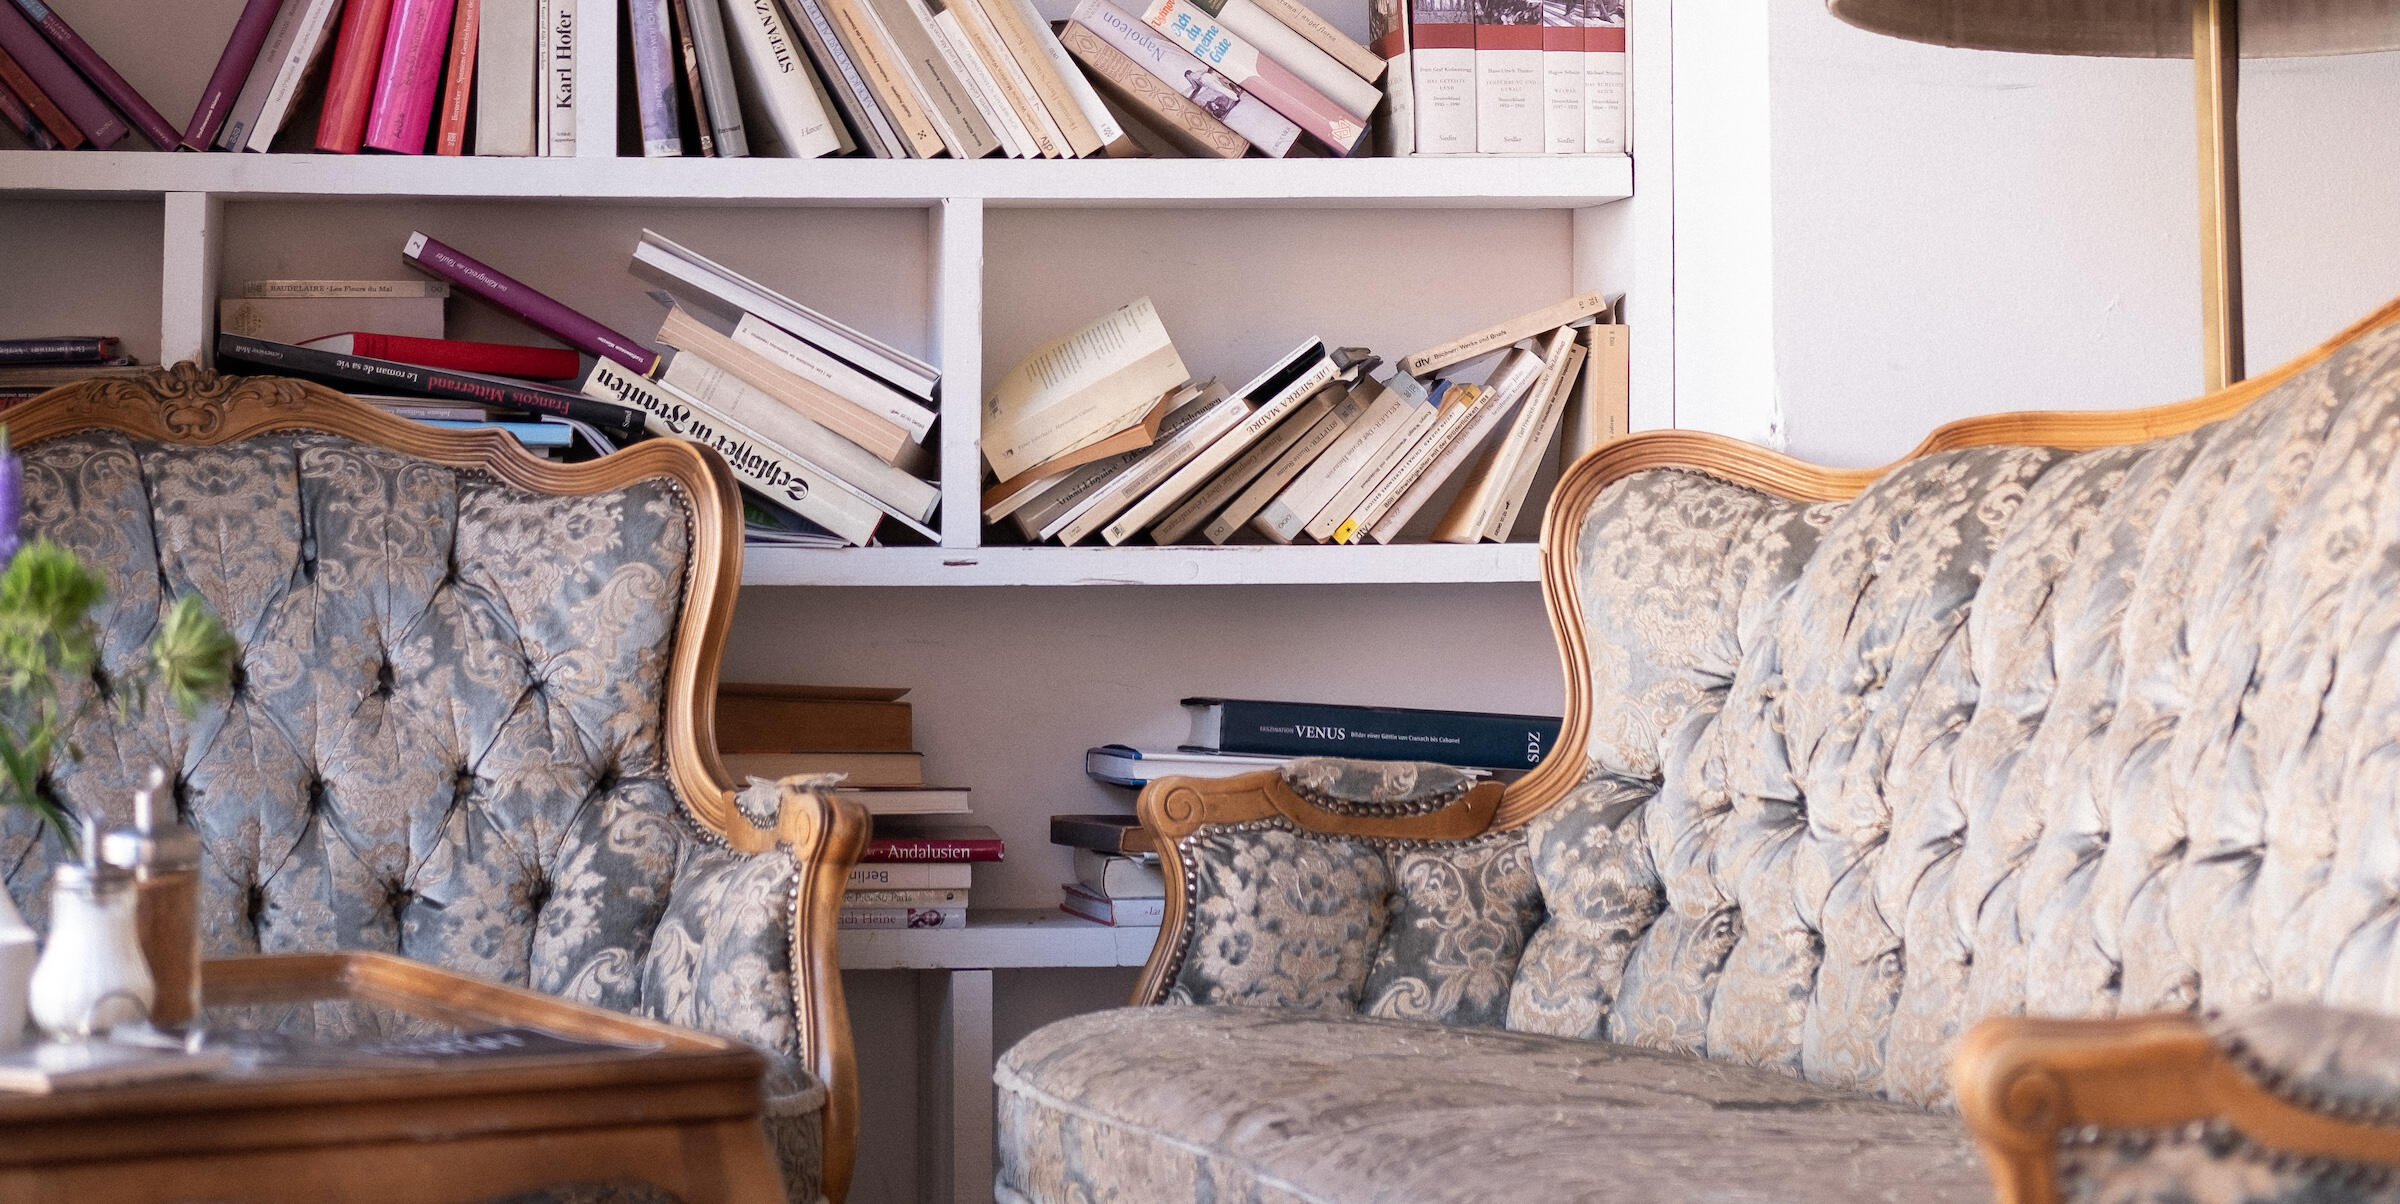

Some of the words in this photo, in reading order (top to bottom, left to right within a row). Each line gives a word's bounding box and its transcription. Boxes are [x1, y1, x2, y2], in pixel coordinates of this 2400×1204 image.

[555, 10, 572, 61] Hofer
[1103, 11, 1168, 62] Napoleon
[1171, 12, 1192, 37] Ach
[1186, 24, 1202, 42] du
[761, 15, 795, 74] STEFAN
[1193, 25, 1219, 58] meine
[1208, 38, 1232, 64] Güte
[556, 67, 572, 109] Karl
[1037, 133, 1055, 153] dtv
[462, 263, 499, 290] Königreich
[269, 285, 325, 293] BAUDELAIRE
[327, 285, 341, 293] Les
[343, 285, 365, 293] Fleurs
[367, 285, 376, 293] du
[378, 285, 393, 293] Mal
[235, 344, 252, 354] Moll
[1432, 346, 1458, 360] Büchner:
[1458, 339, 1478, 351] Werke
[1478, 335, 1490, 344] und
[1489, 329, 1507, 340] Briefe
[336, 359, 350, 370] vie
[350, 363, 361, 372] sa
[361, 362, 373, 374] de
[374, 367, 405, 381] roman
[1413, 355, 1431, 369] dtv
[405, 371, 418, 383] Le
[427, 376, 505, 403] Mitterrand
[596, 368, 691, 433] Franken
[1279, 377, 1315, 410] SIERRA
[505, 394, 570, 416] François
[1373, 400, 1401, 429] KELLER
[690, 420, 712, 443] in
[1244, 402, 1281, 437] MADRE
[1393, 456, 1433, 496] Schwierigkeiten
[1428, 446, 1440, 458] mit
[1436, 438, 1448, 449] der
[1444, 404, 1481, 441] Brüderlichkeit
[711, 433, 811, 501] Schlösser
[1355, 524, 1369, 539] dtv
[1295, 725, 1346, 740] VENUS
[1408, 734, 1429, 743] Cranach
[1439, 736, 1460, 744] Cabanel
[1527, 731, 1540, 762] SDZ
[887, 844, 970, 859] Andalusien
[849, 871, 889, 883] Berlin
[862, 913, 896, 925] Heine
